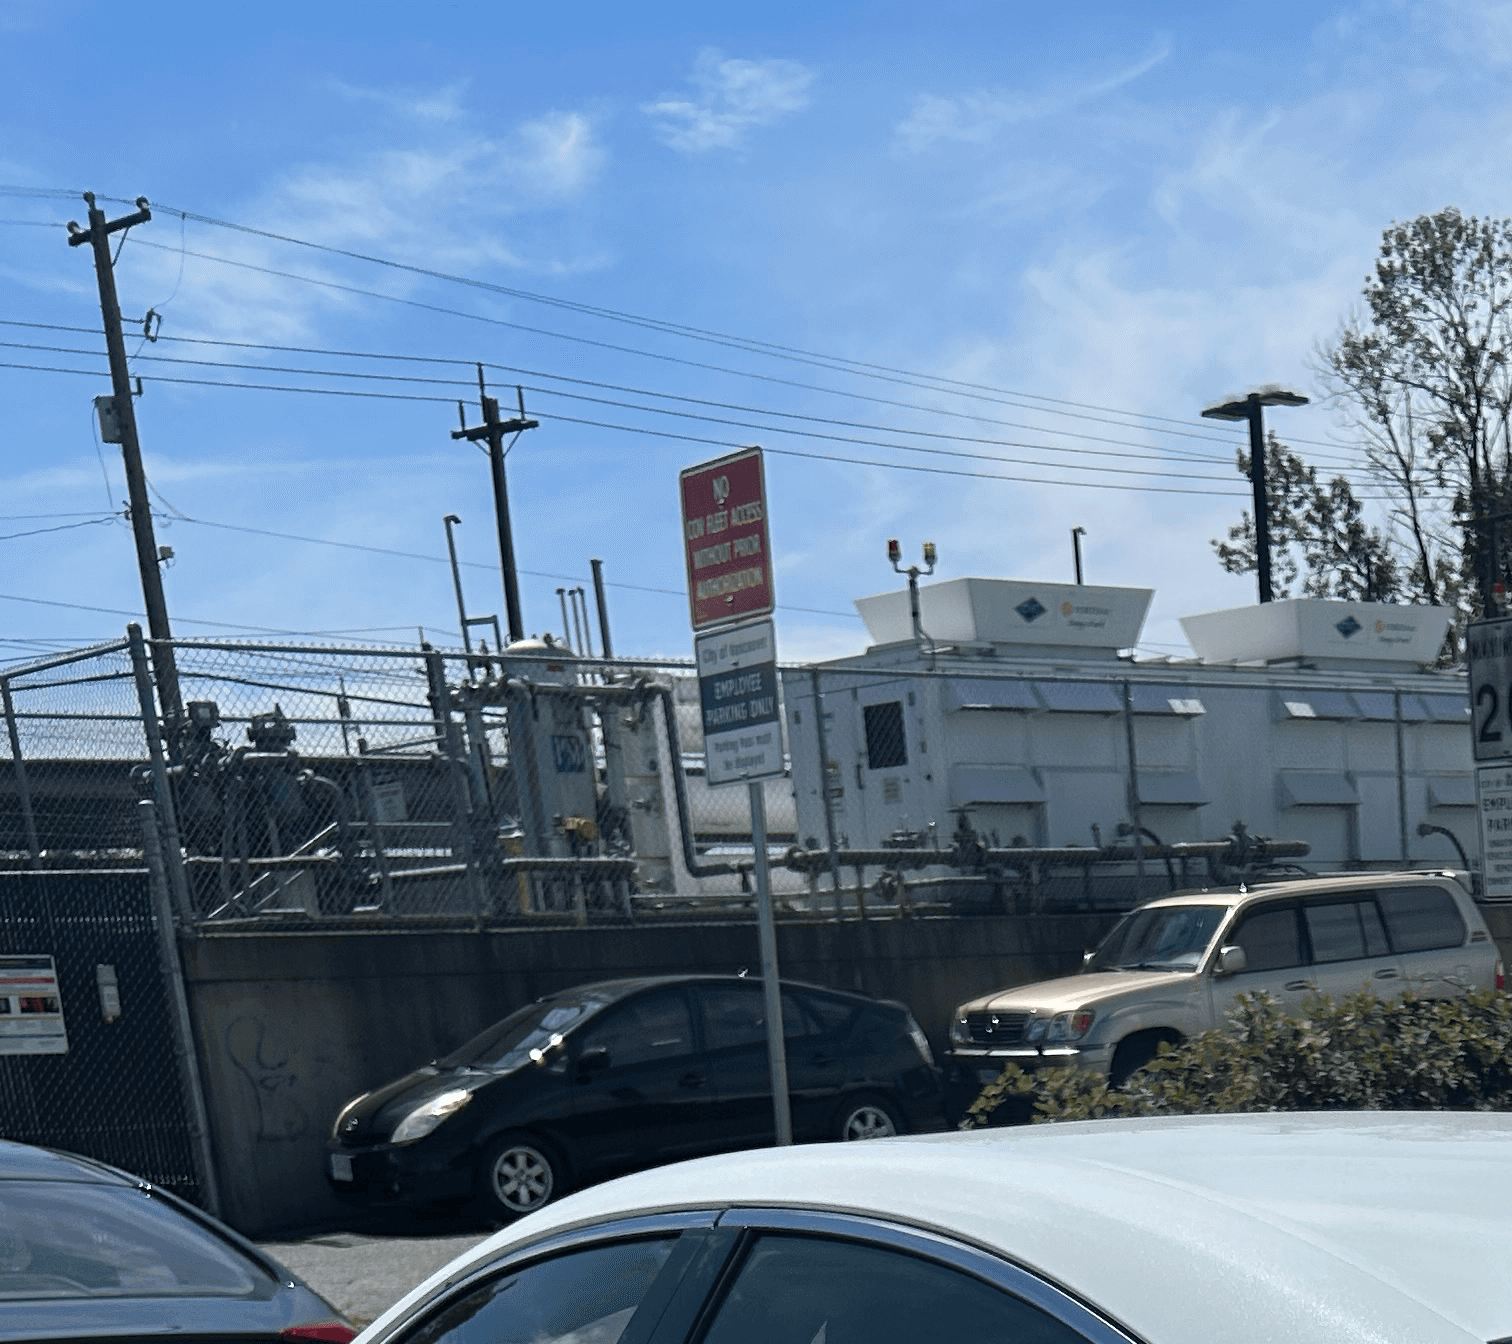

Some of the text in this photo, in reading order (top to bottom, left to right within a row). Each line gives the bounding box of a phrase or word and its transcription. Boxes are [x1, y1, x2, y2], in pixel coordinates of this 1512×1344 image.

[712, 475, 730, 501] NO
[713, 671, 762, 700] EMPLOYEE
[705, 696, 774, 727] PARKING ONLY
